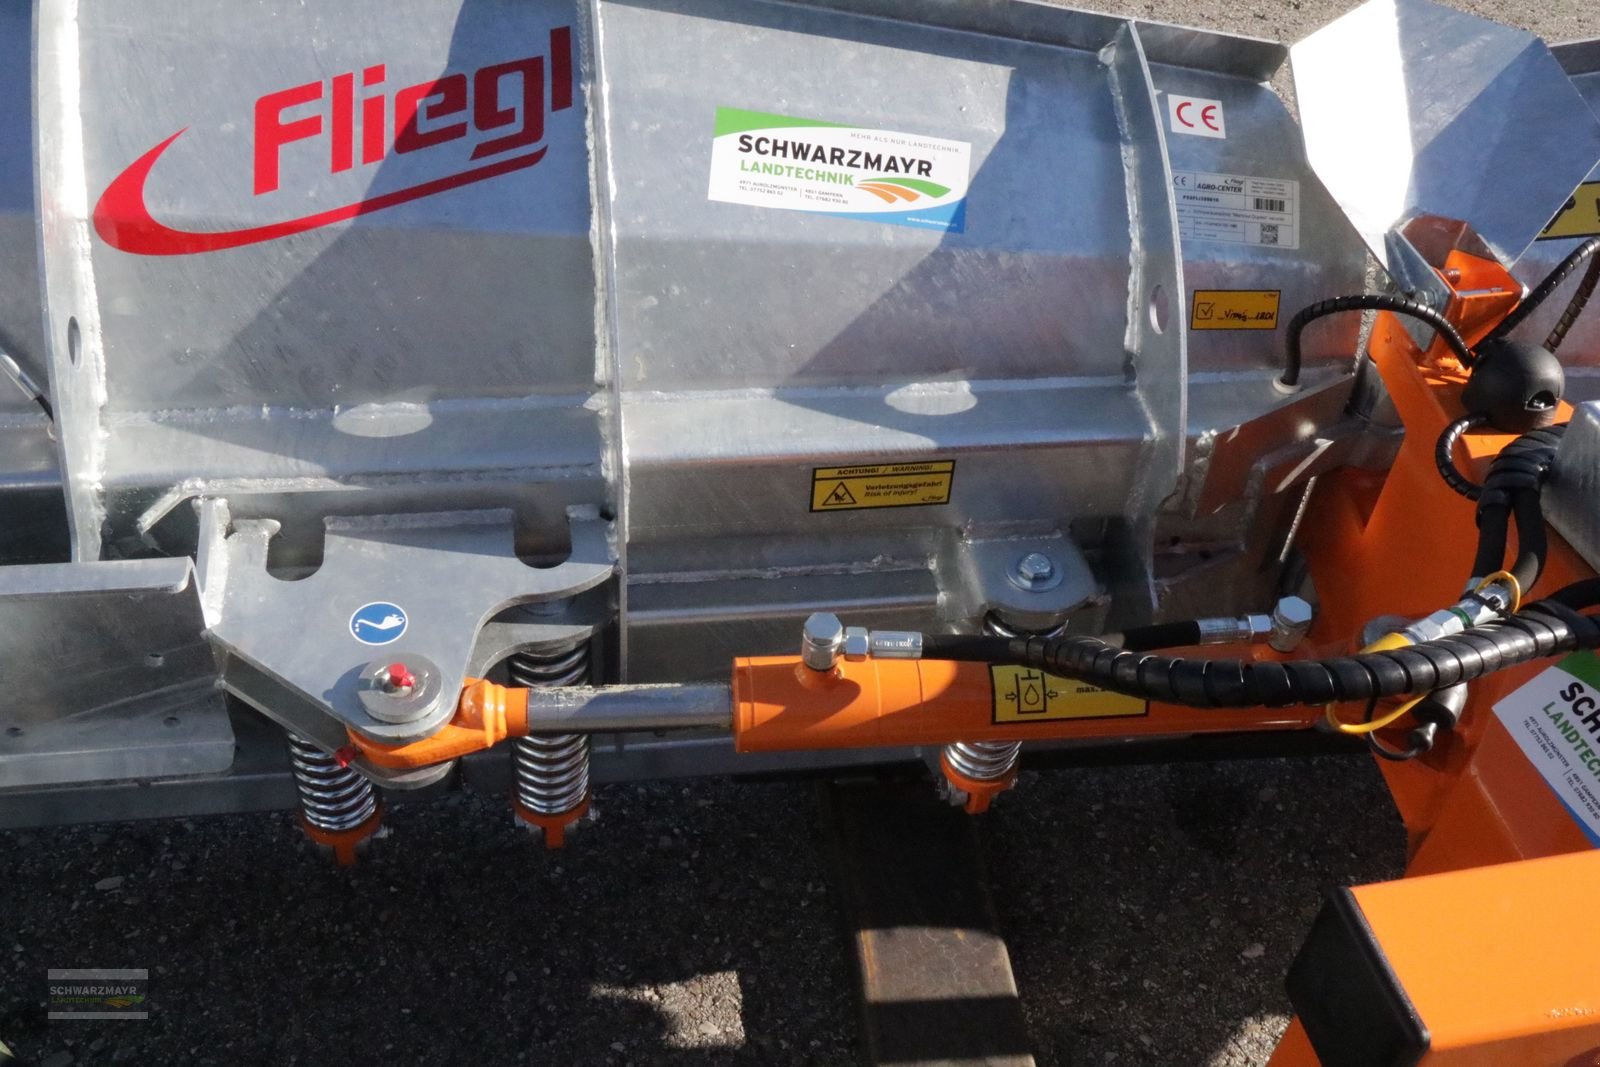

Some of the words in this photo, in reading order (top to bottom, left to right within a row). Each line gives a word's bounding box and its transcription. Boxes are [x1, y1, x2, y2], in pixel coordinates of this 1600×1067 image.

[254, 25, 573, 196] Fliegl
[850, 132, 871, 141] MEHR
[874, 135, 888, 143] ALS
[891, 137, 906, 145] NUR
[738, 134, 932, 177] SCHWARZMAYR
[740, 159, 854, 186] LANDTECHNIK
[1197, 183, 1242, 193] AGRO-CENTER
[837, 466, 879, 476] ACHTUNG!
[892, 464, 933, 473] WARNING!
